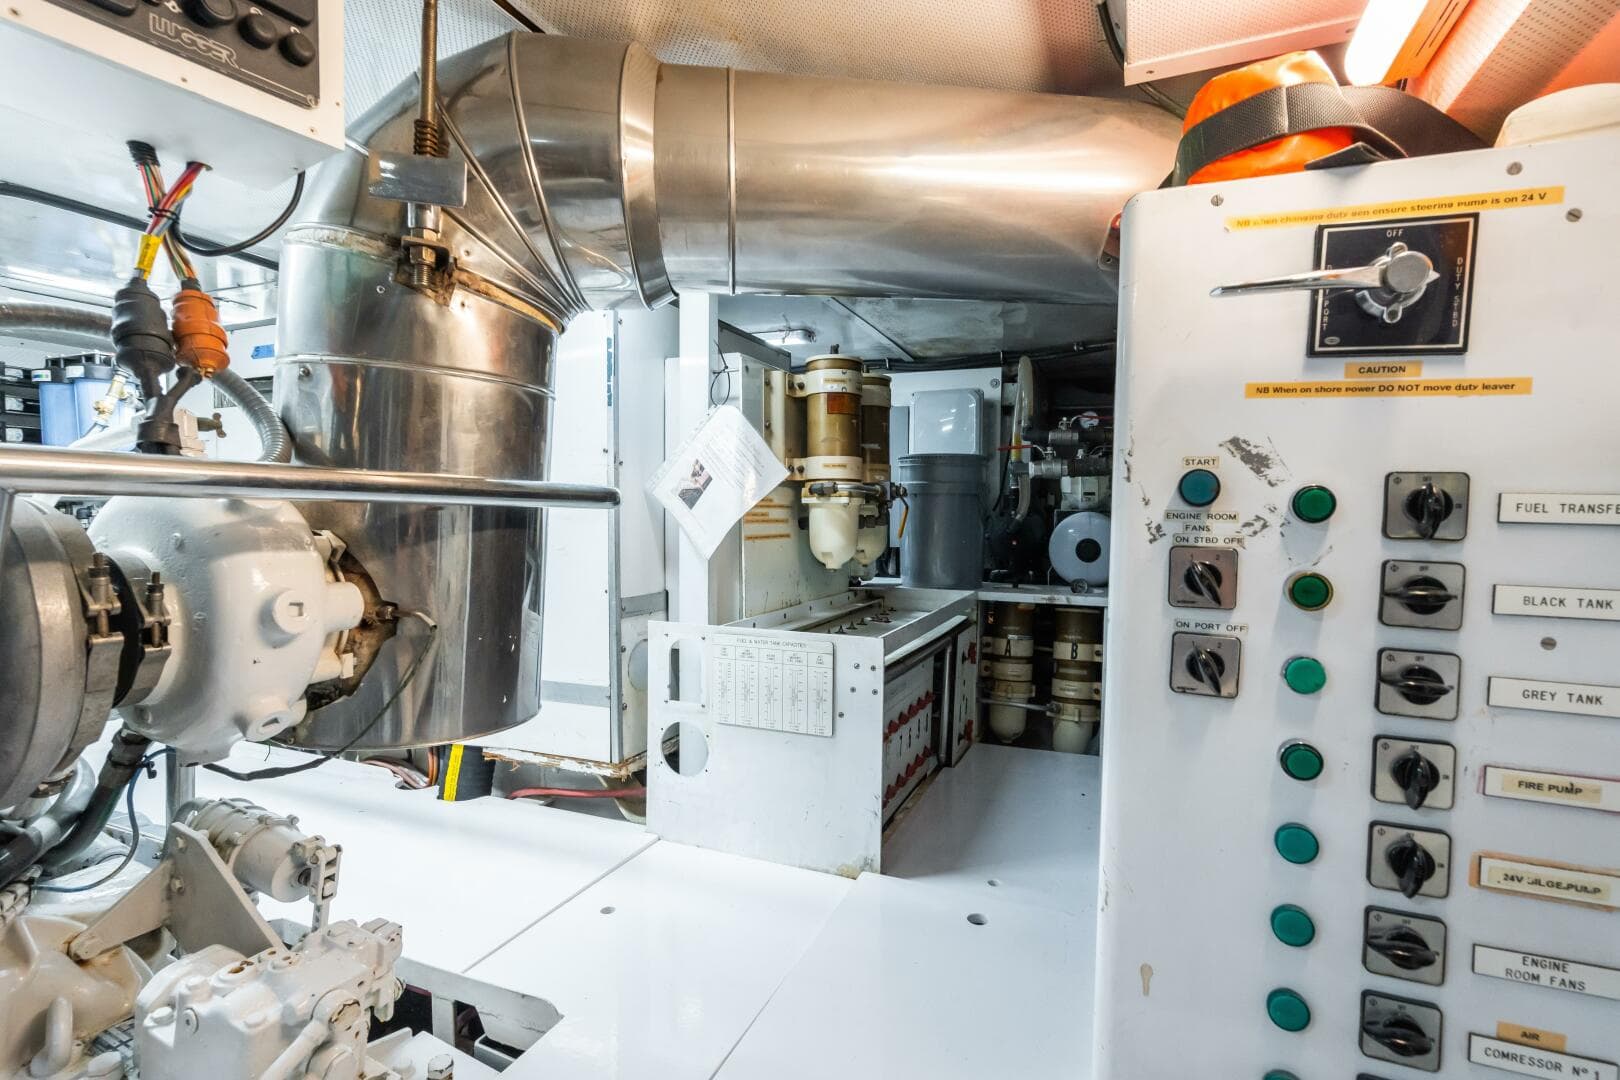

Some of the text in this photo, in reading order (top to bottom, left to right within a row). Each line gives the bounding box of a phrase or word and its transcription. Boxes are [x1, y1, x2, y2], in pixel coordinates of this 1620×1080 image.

[1372, 206, 1408, 215] ensure
[1410, 200, 1454, 212] steering
[1490, 197, 1501, 205] is
[1503, 196, 1518, 205] on
[1521, 193, 1534, 203] 24
[1538, 191, 1548, 201] V
[1386, 228, 1404, 238] OFF
[1455, 256, 1464, 291] DUTY
[1321, 300, 1331, 331] PORT
[1357, 364, 1407, 375] CAUTION
[1256, 386, 1270, 395] NB
[1272, 385, 1298, 394] When
[1300, 386, 1312, 394] on
[1314, 384, 1342, 394] shore
[1378, 384, 1395, 393] DO
[1397, 383, 1420, 392] NOT
[1423, 384, 1452, 393] move
[1481, 381, 1516, 391] leaver
[1184, 458, 1217, 466] START
[1515, 502, 1549, 514] FUEL
[1166, 511, 1237, 521] ENGINE ROOM
[1184, 523, 1211, 532] FANS
[1175, 536, 1244, 545] ON STBD OFF
[1522, 595, 1614, 610] BLACK TANK
[1194, 622, 1221, 631] PORT
[1226, 624, 1246, 632] OFF
[1004, 638, 1012, 657] A
[1070, 642, 1079, 660] B
[1521, 688, 1604, 706] GREY TANK
[1517, 779, 1584, 796] FIRE PUMP
[1521, 955, 1570, 974] ENGINE
[1504, 967, 1586, 992] ROOM FANS
[1520, 1030, 1541, 1042] AIR
[1484, 1047, 1563, 1073] COMRESSOR
